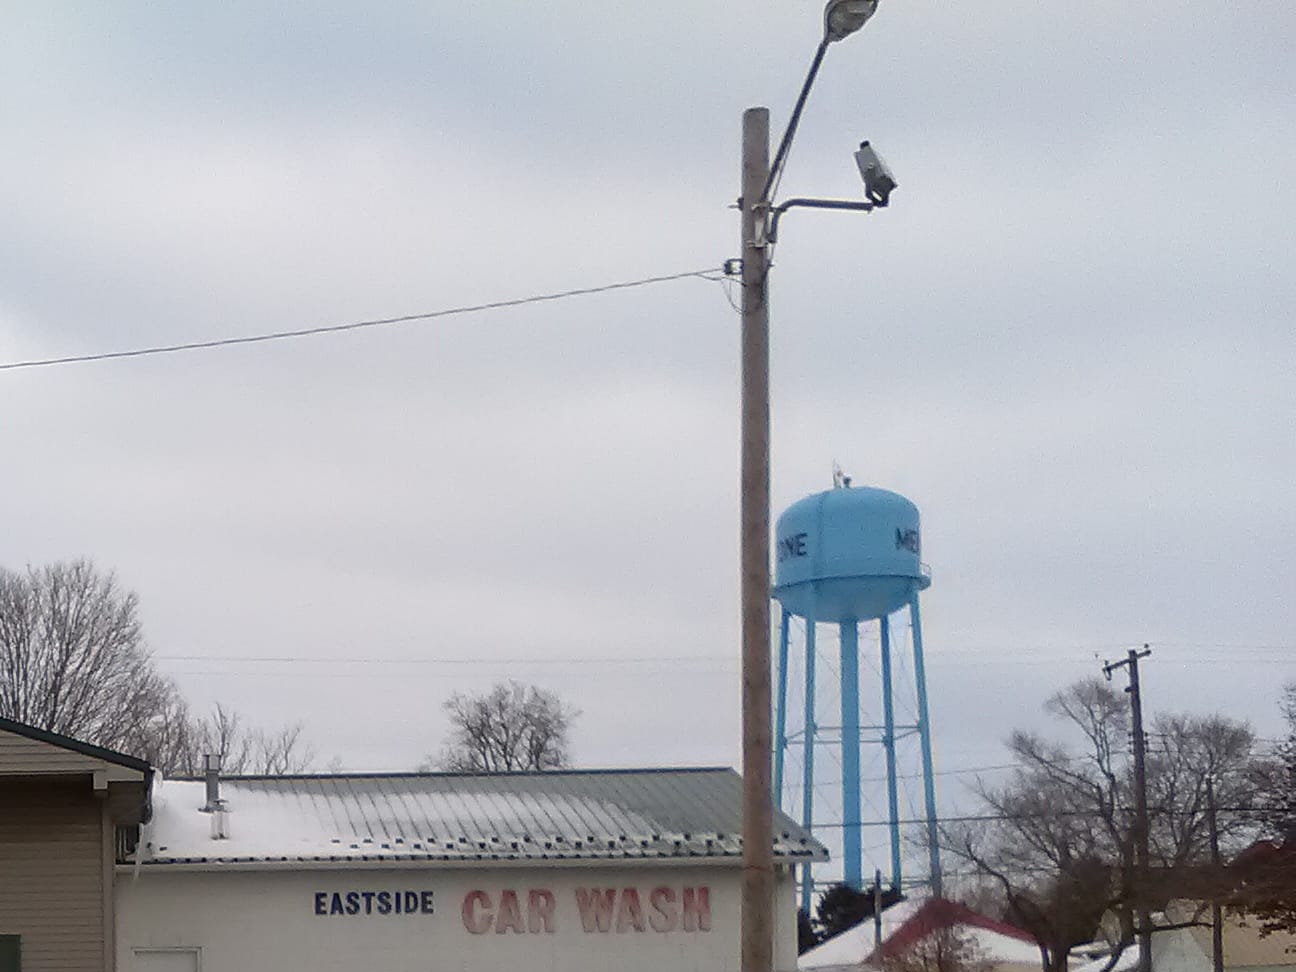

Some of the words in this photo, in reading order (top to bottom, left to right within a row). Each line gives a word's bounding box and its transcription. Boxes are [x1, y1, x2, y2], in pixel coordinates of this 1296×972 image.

[314, 890, 434, 915] EASTSIDE
[461, 888, 555, 934] CAR
[575, 886, 712, 934] WASH
